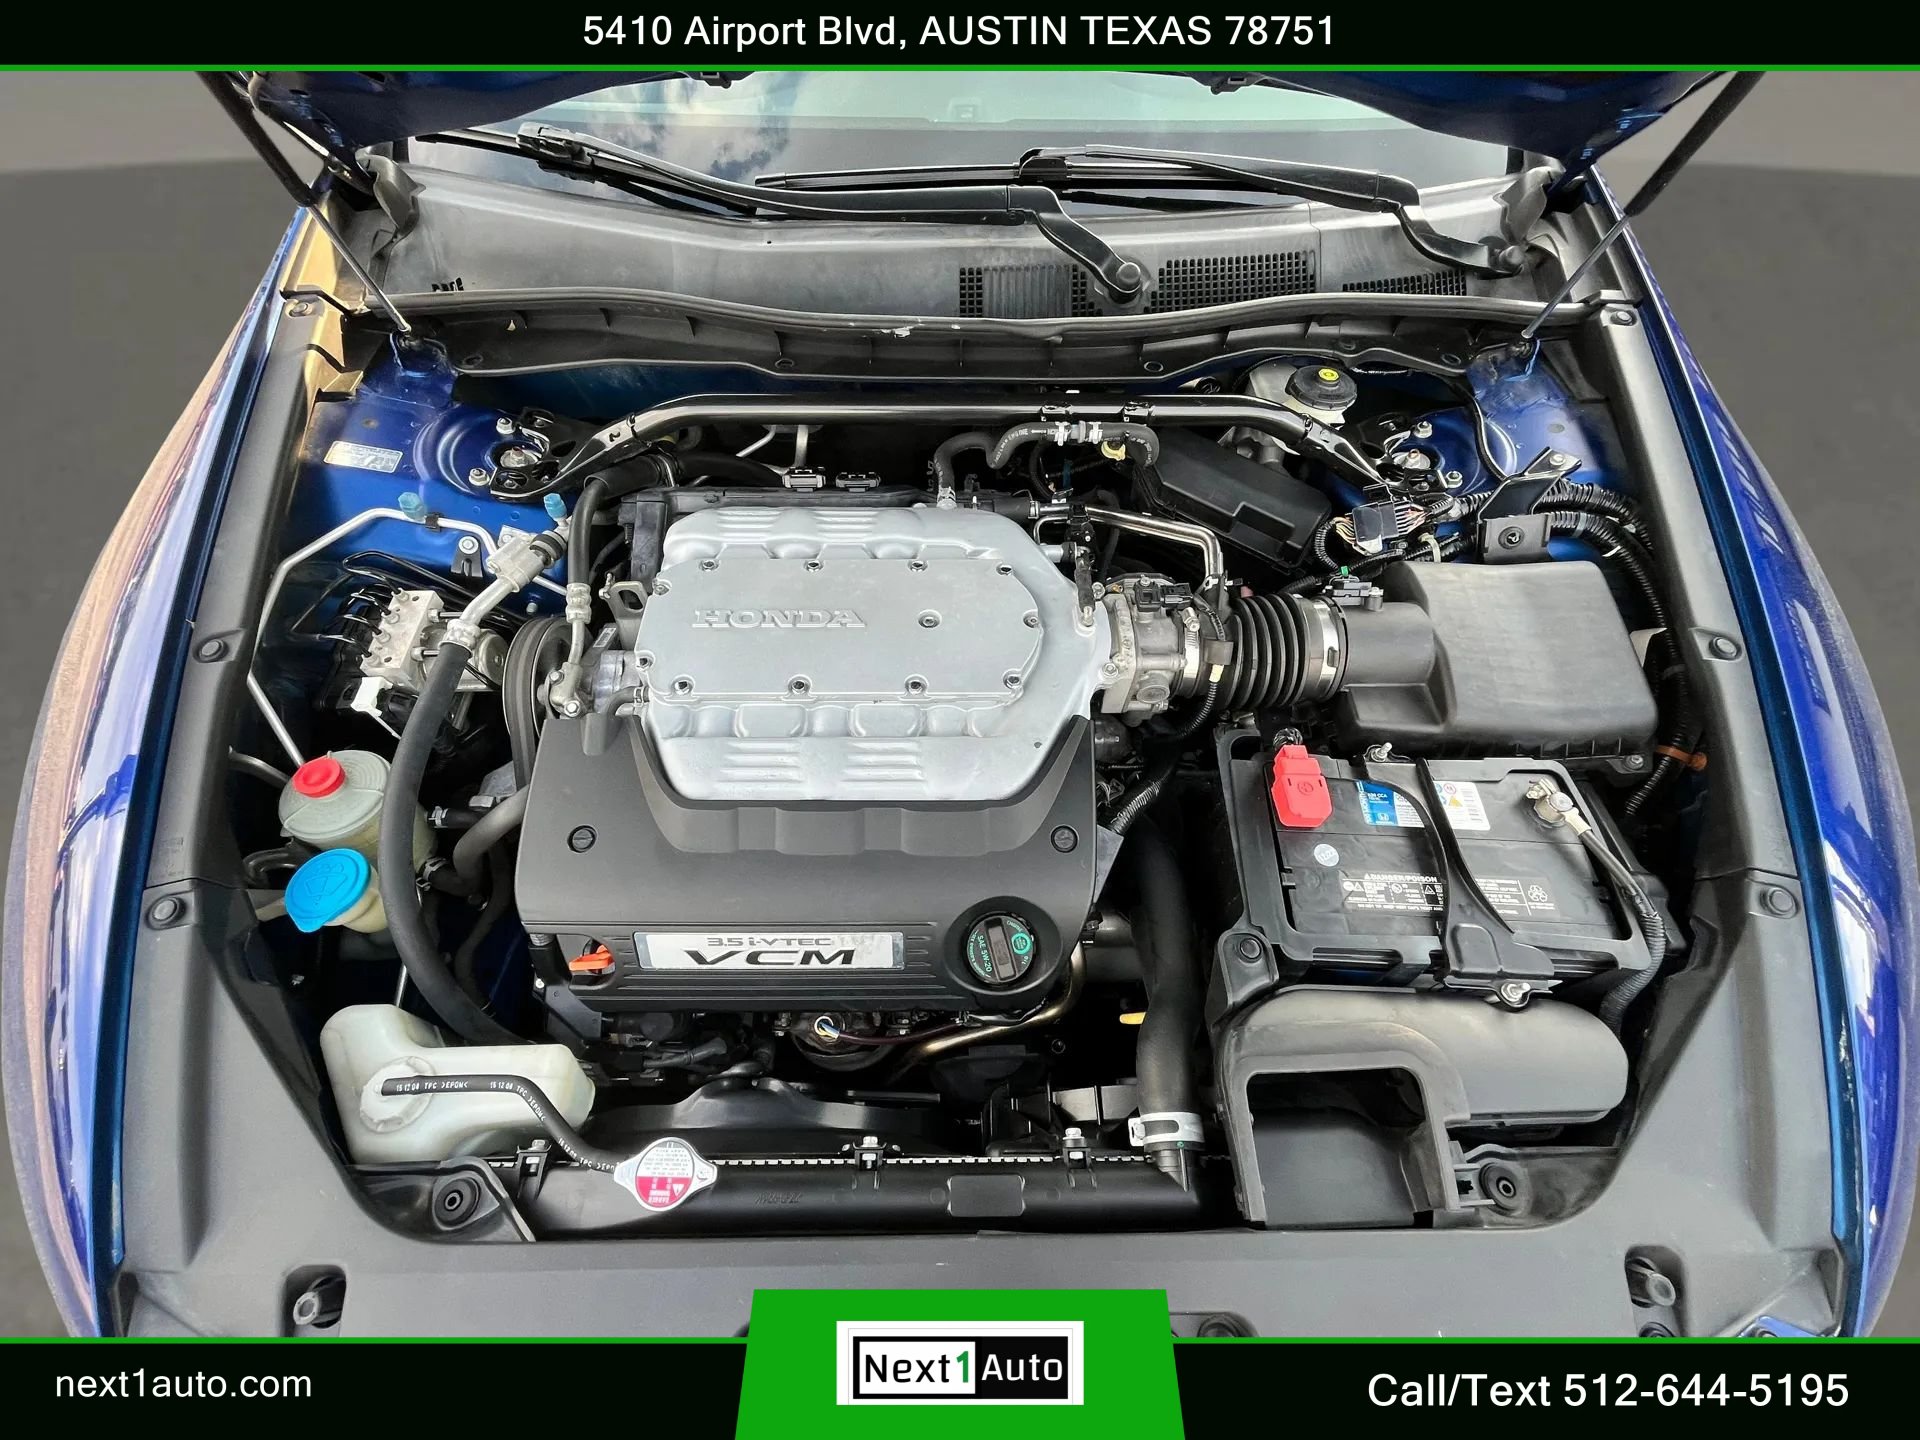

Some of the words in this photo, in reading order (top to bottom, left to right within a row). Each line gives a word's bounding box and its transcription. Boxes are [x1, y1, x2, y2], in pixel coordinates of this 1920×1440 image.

[691, 607, 868, 629] HONDA
[706, 936, 744, 947] 3.5
[748, 936, 833, 947] i-VTEC
[977, 935, 987, 949] SAE
[683, 948, 856, 966] VCM
[981, 949, 993, 973] 5W-20
